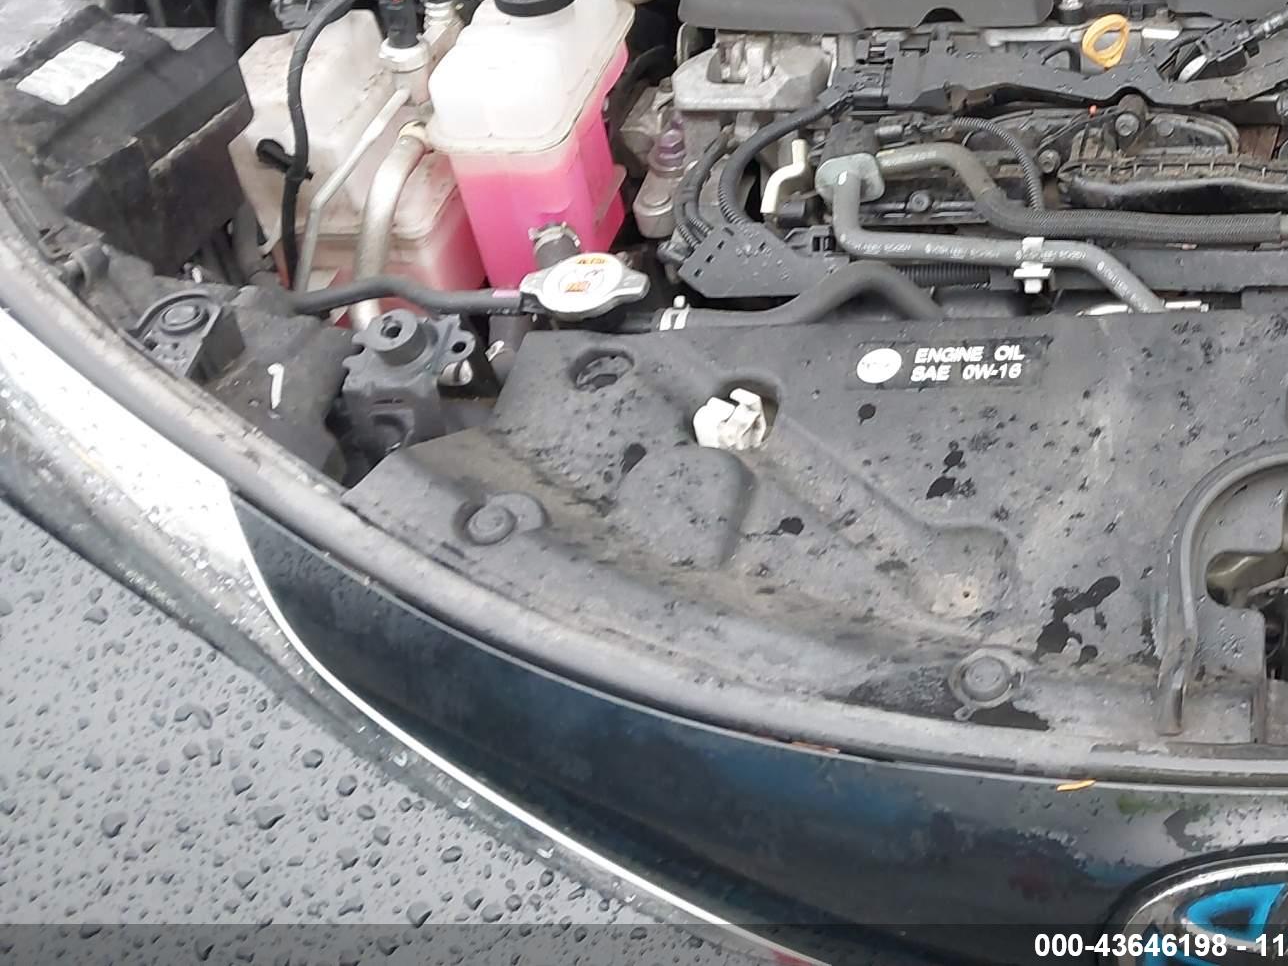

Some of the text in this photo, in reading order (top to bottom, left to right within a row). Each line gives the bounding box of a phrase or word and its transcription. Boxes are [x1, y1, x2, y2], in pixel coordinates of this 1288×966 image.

[914, 344, 1026, 363] ENGINE OIL
[910, 363, 1022, 382] SAE 0W-16
